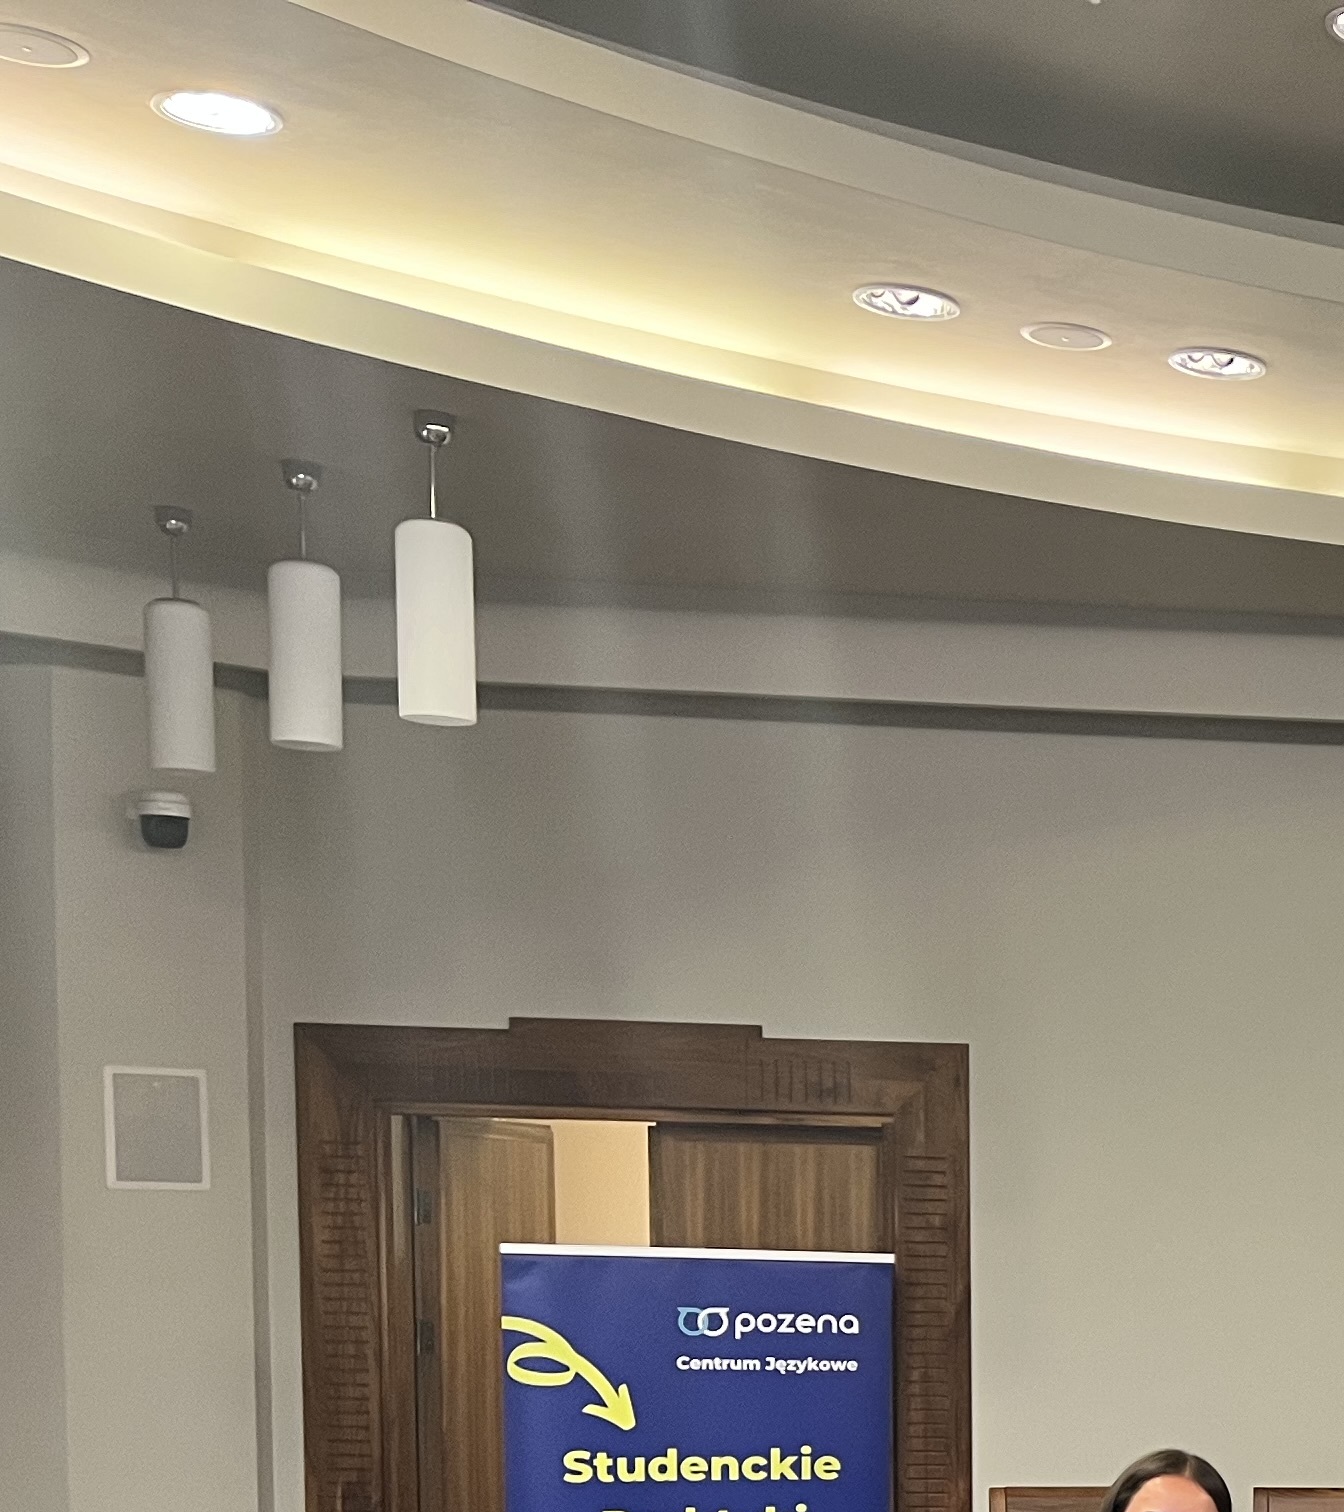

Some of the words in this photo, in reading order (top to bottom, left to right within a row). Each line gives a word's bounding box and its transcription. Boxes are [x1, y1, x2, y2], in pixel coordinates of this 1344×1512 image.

[734, 1312, 860, 1340] pozena
[676, 1355, 761, 1372] Centrum
[765, 1356, 859, 1374] Językowe
[562, 1445, 842, 1484] Studenckie
